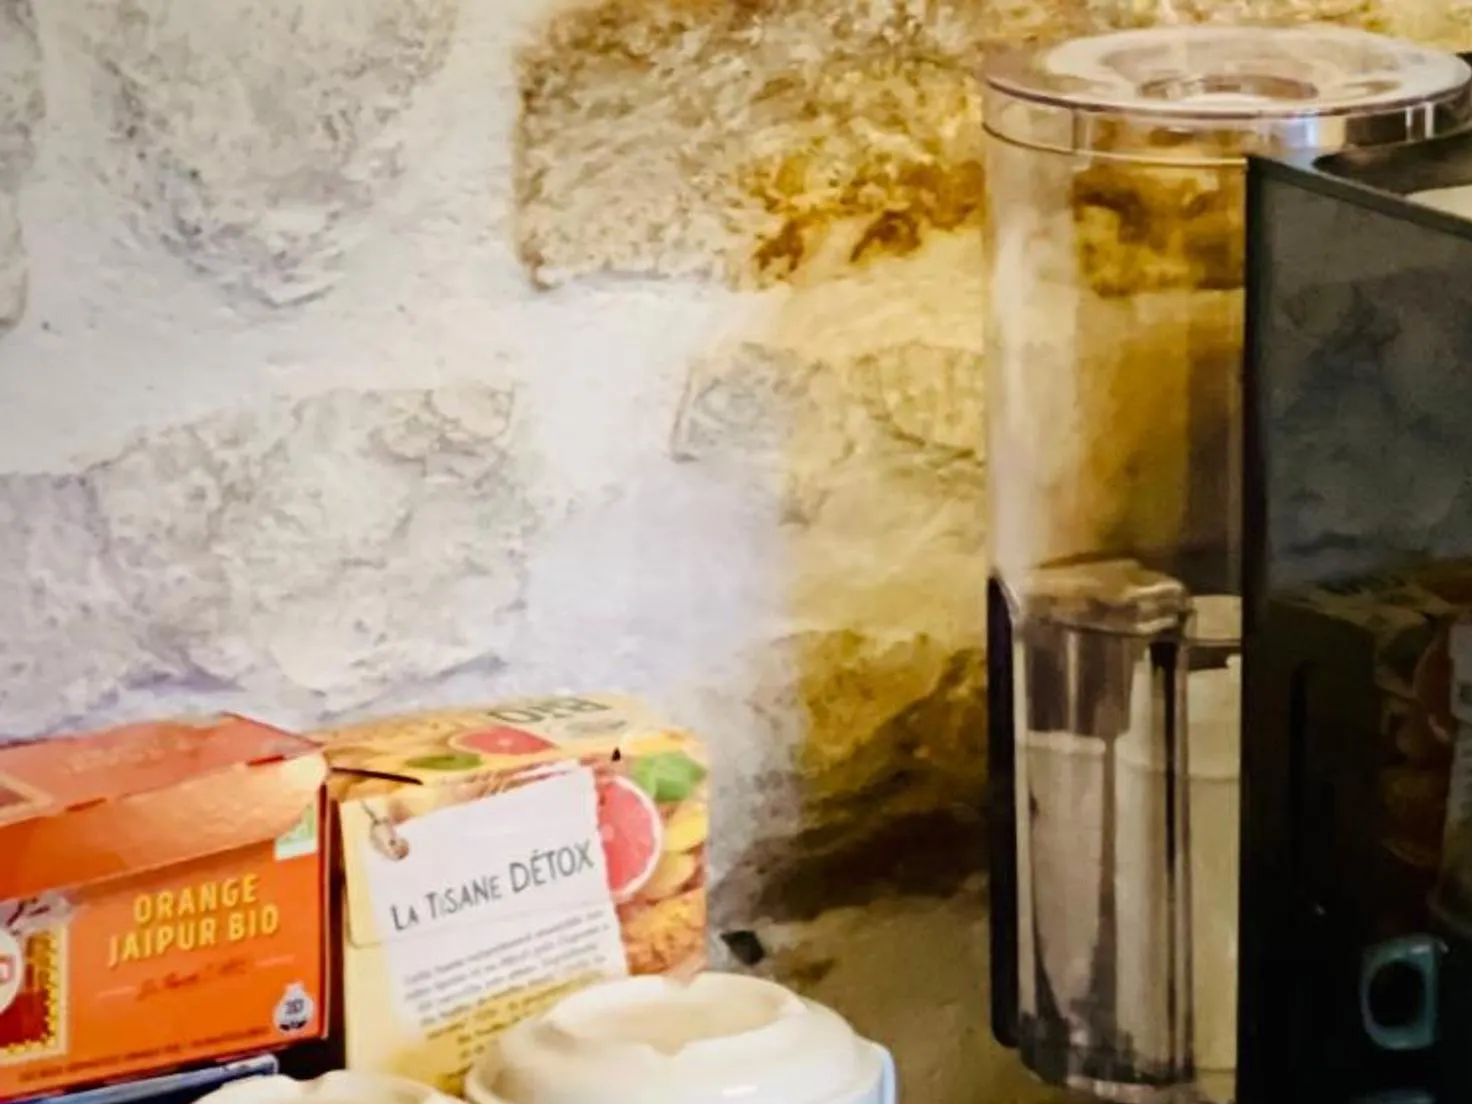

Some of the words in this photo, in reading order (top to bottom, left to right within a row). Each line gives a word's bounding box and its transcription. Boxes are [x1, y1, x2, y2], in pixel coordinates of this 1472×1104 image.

[508, 839, 596, 895] DÉTOX
[133, 874, 258, 925] ORANGE
[106, 917, 217, 969] JAIPUR
[228, 903, 279, 942] BIO
